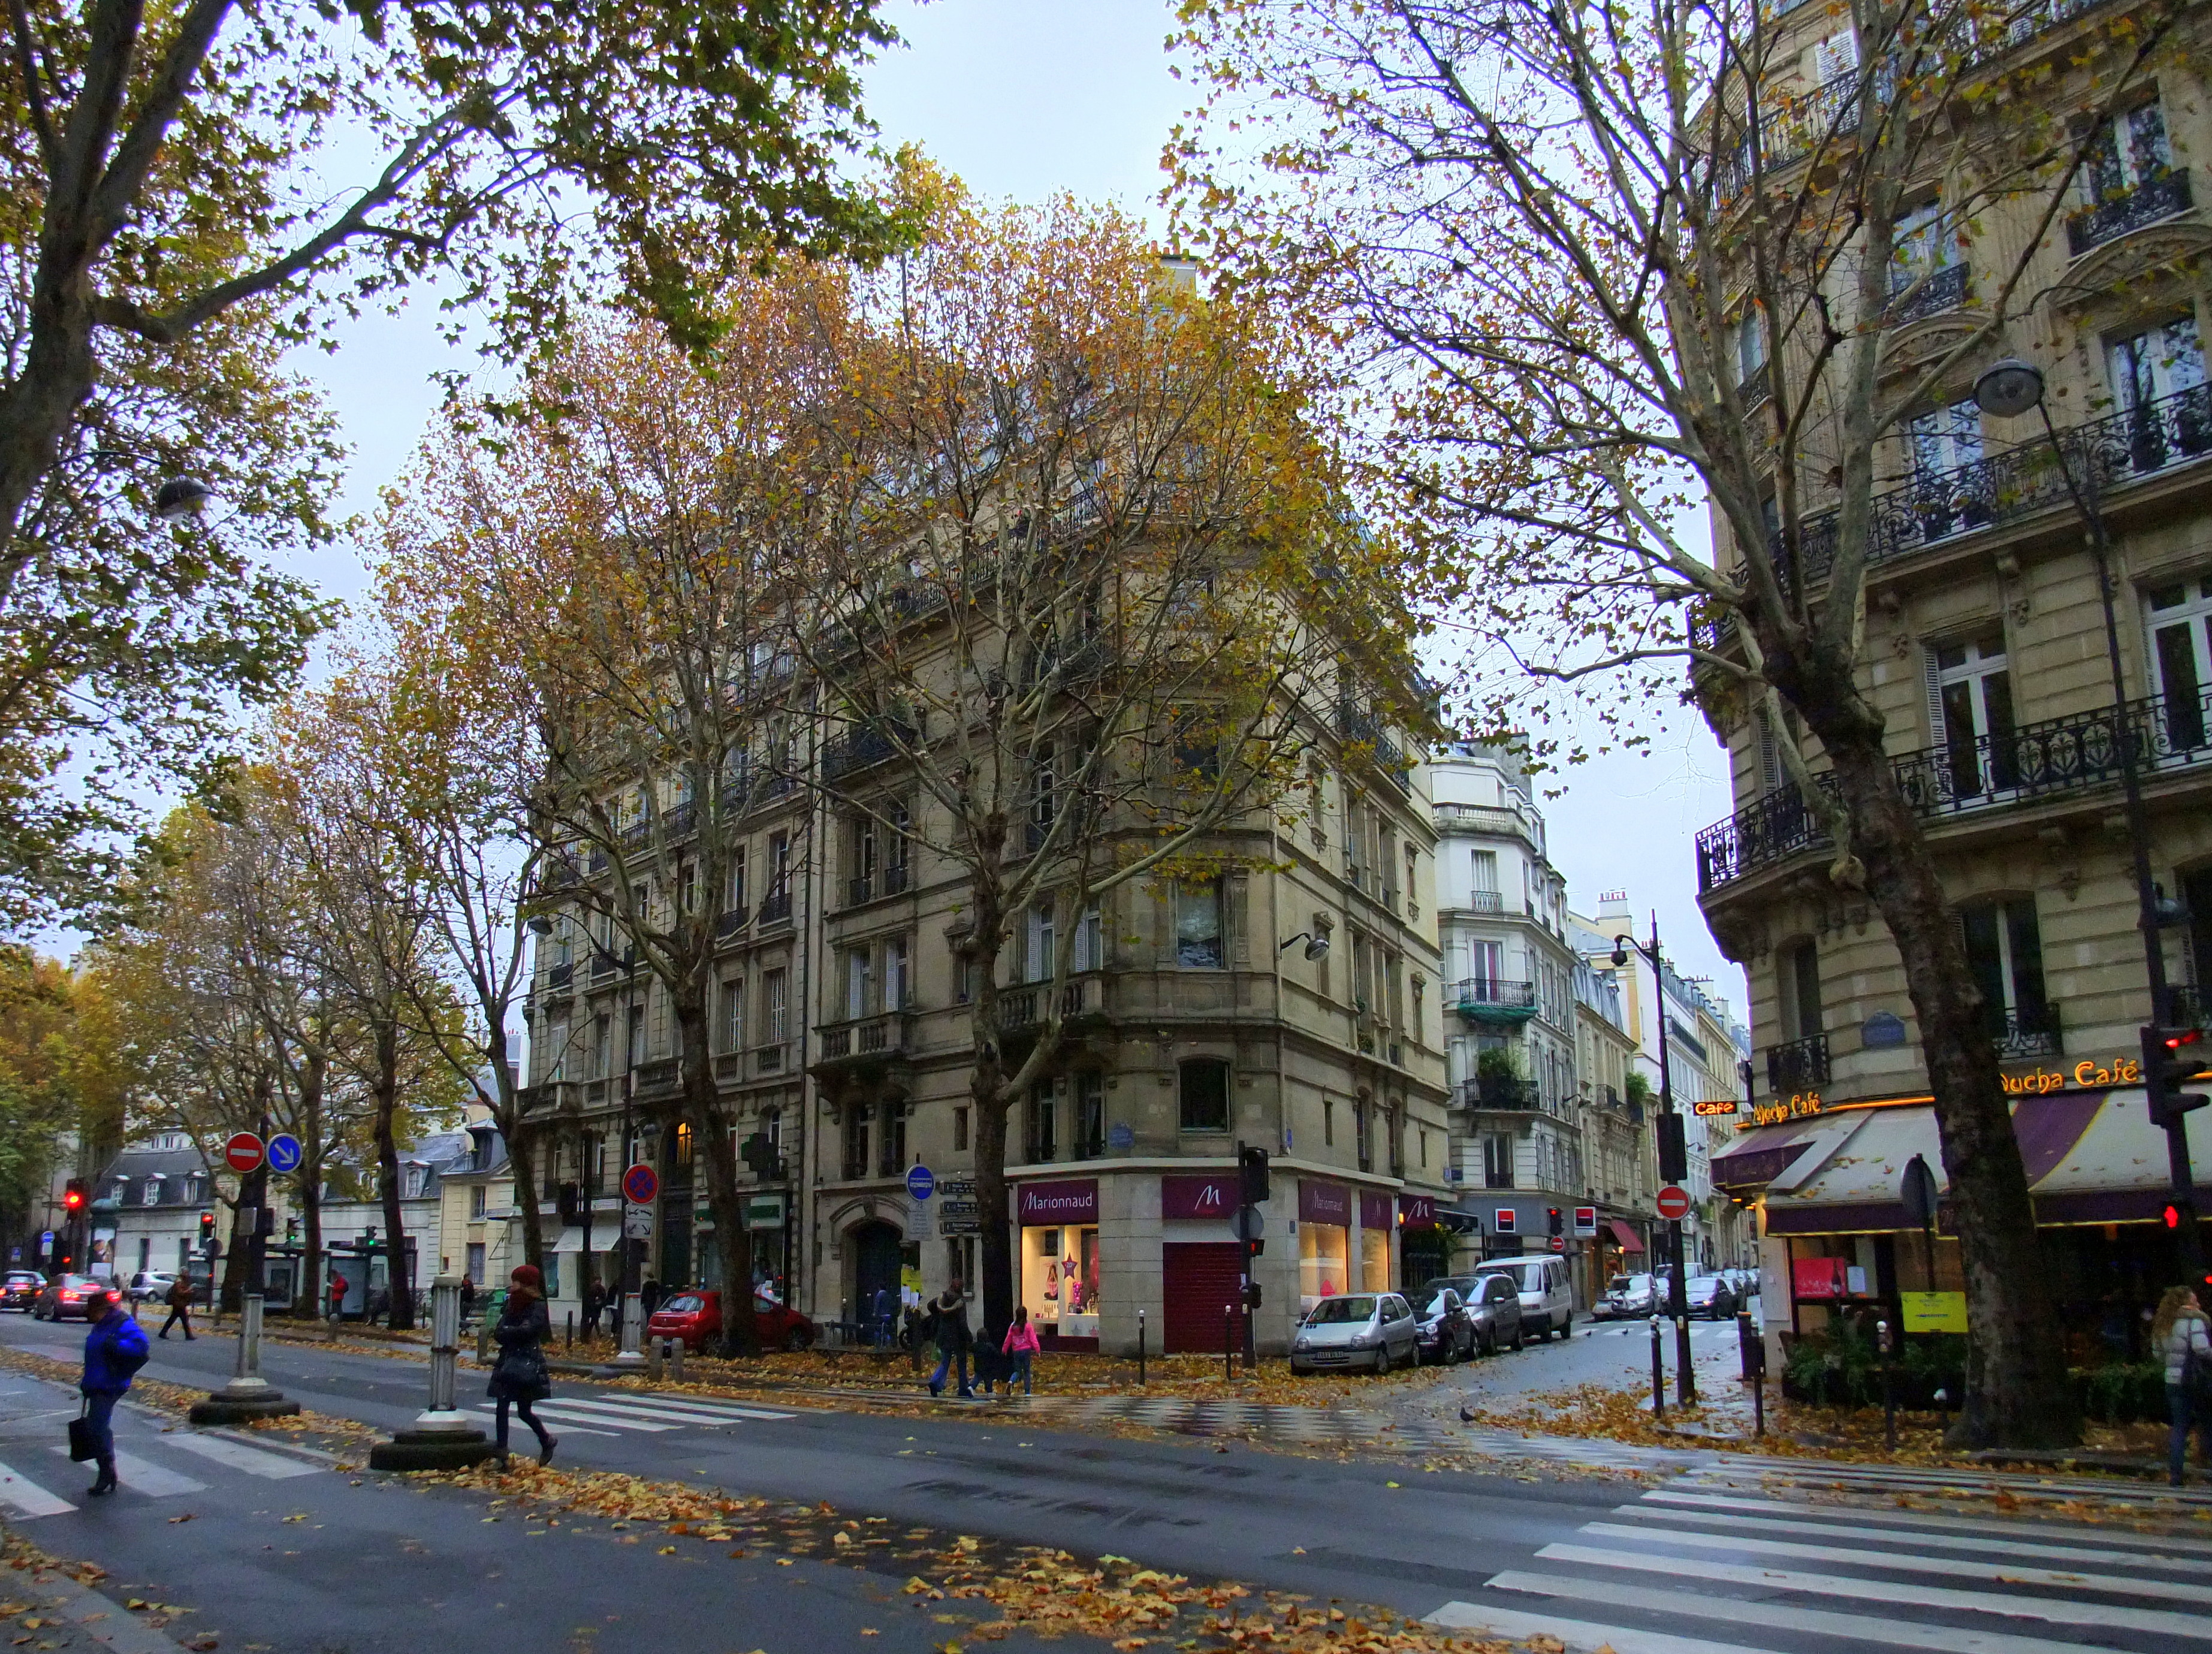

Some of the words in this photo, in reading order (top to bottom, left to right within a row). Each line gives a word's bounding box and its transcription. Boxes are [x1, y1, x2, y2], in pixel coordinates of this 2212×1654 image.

[2075, 1058, 2138, 1086] Café
[1754, 1099, 1789, 1125] Mucha
[1791, 1091, 1821, 1115] Café
[1022, 1191, 1093, 1215] Marionnaud
[1195, 1185, 1220, 1210] M
[1407, 1200, 1428, 1222] M
